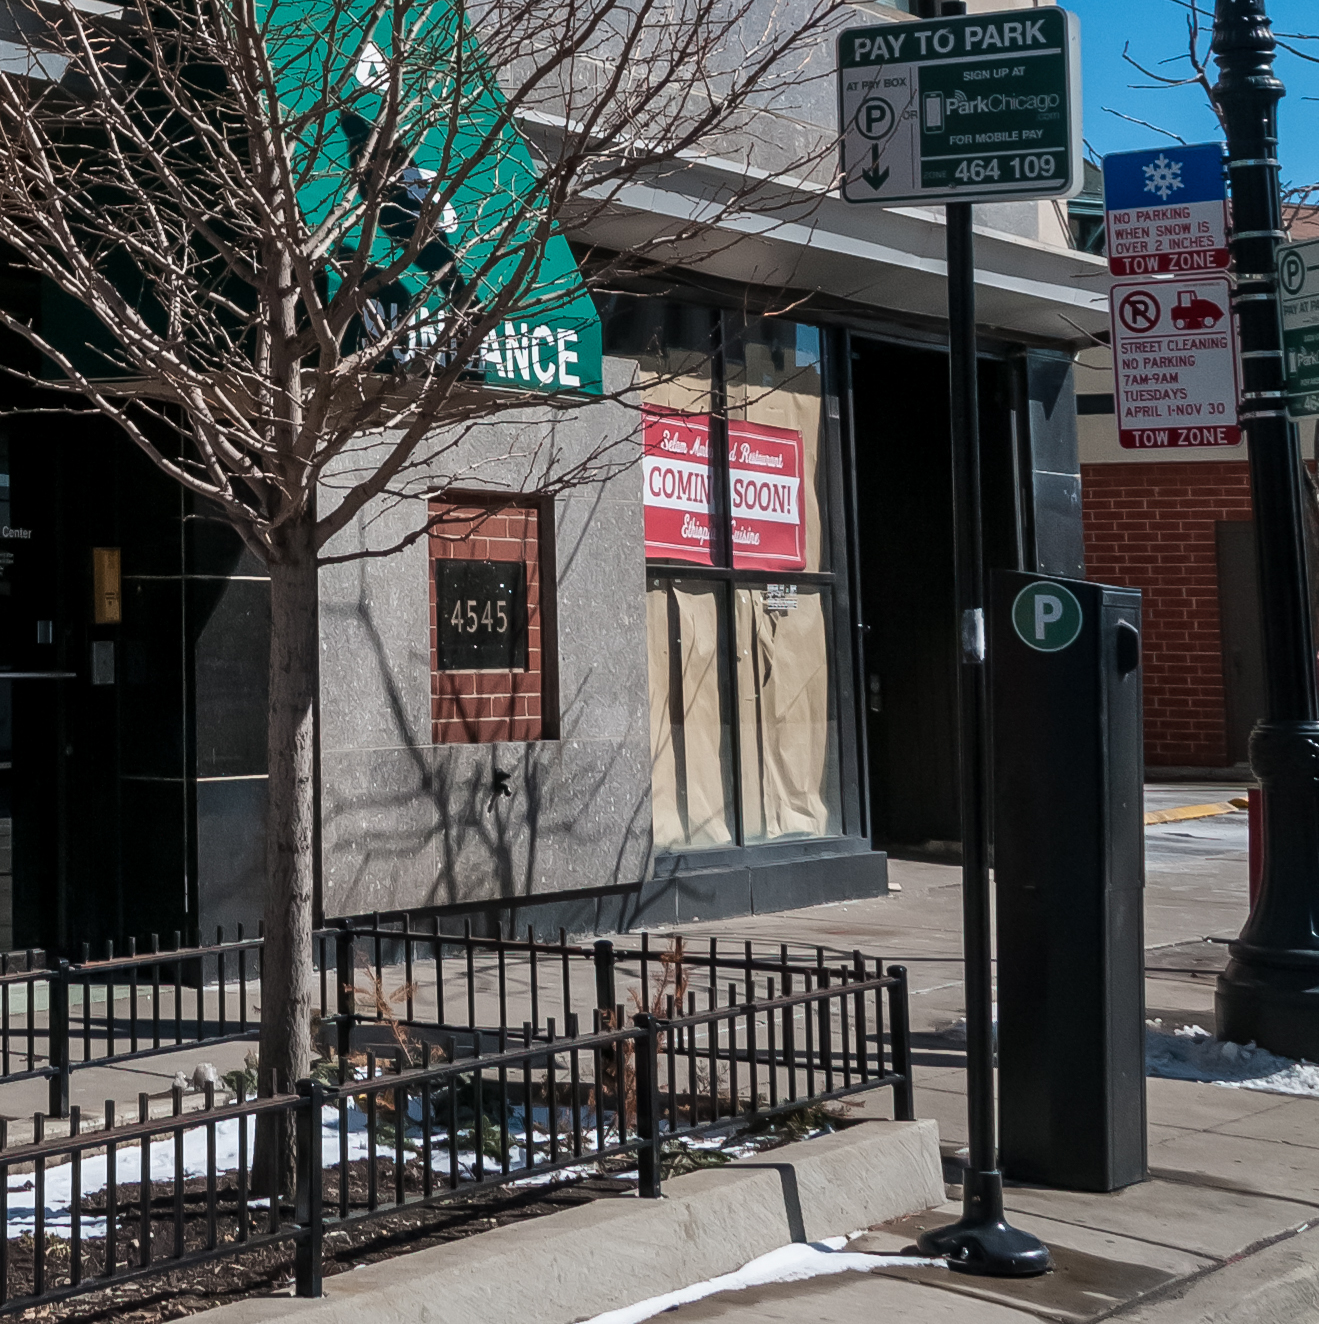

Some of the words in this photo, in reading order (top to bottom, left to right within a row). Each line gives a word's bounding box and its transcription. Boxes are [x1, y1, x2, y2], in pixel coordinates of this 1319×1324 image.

[854, 33, 906, 62] PAY
[915, 27, 955, 55] TO
[965, 19, 1046, 50] PARK
[963, 70, 990, 81] SIGN
[993, 68, 1009, 78] UP
[1012, 66, 1025, 76] AT
[846, 82, 859, 91] AT
[862, 80, 881, 90] PAY
[884, 77, 907, 88] BOX
[945, 93, 1059, 115] ParkChicago
[902, 110, 918, 120] OR
[950, 135, 972, 145] FOR
[976, 131, 1019, 143] MOBILE
[1023, 130, 1044, 140] PAY
[955, 158, 1001, 182] 464
[1010, 155, 1055, 179] 109
[1114, 212, 1130, 225] NO
[1136, 207, 1190, 222] PARKING
[1115, 226, 1149, 240] WHEN
[1156, 223, 1191, 237] SNOW
[1198, 221, 1210, 233] IS
[1116, 241, 1148, 254] OVER
[1155, 240, 1163, 251] 2
[1169, 235, 1215, 250] INCHES
[1123, 256, 1159, 274] TOW
[1168, 252, 1216, 270] ZONE
[1121, 340, 1163, 354] STREET
[1167, 337, 1228, 352] CLEANING
[1122, 358, 1138, 370] NO
[1143, 355, 1195, 369] PARKING
[1123, 372, 1179, 386] 7AM-9AM
[1124, 388, 1187, 402] TUESDAYS
[1125, 406, 1162, 418] APRIL
[1208, 402, 1225, 415] 30
[1132, 430, 1168, 447] TOW
[1178, 428, 1228, 445] ZONE
[649, 466, 711, 504] COMIN
[733, 478, 792, 515] SOON!
[2, 525, 33, 539] Center
[450, 599, 509, 633] 4545
